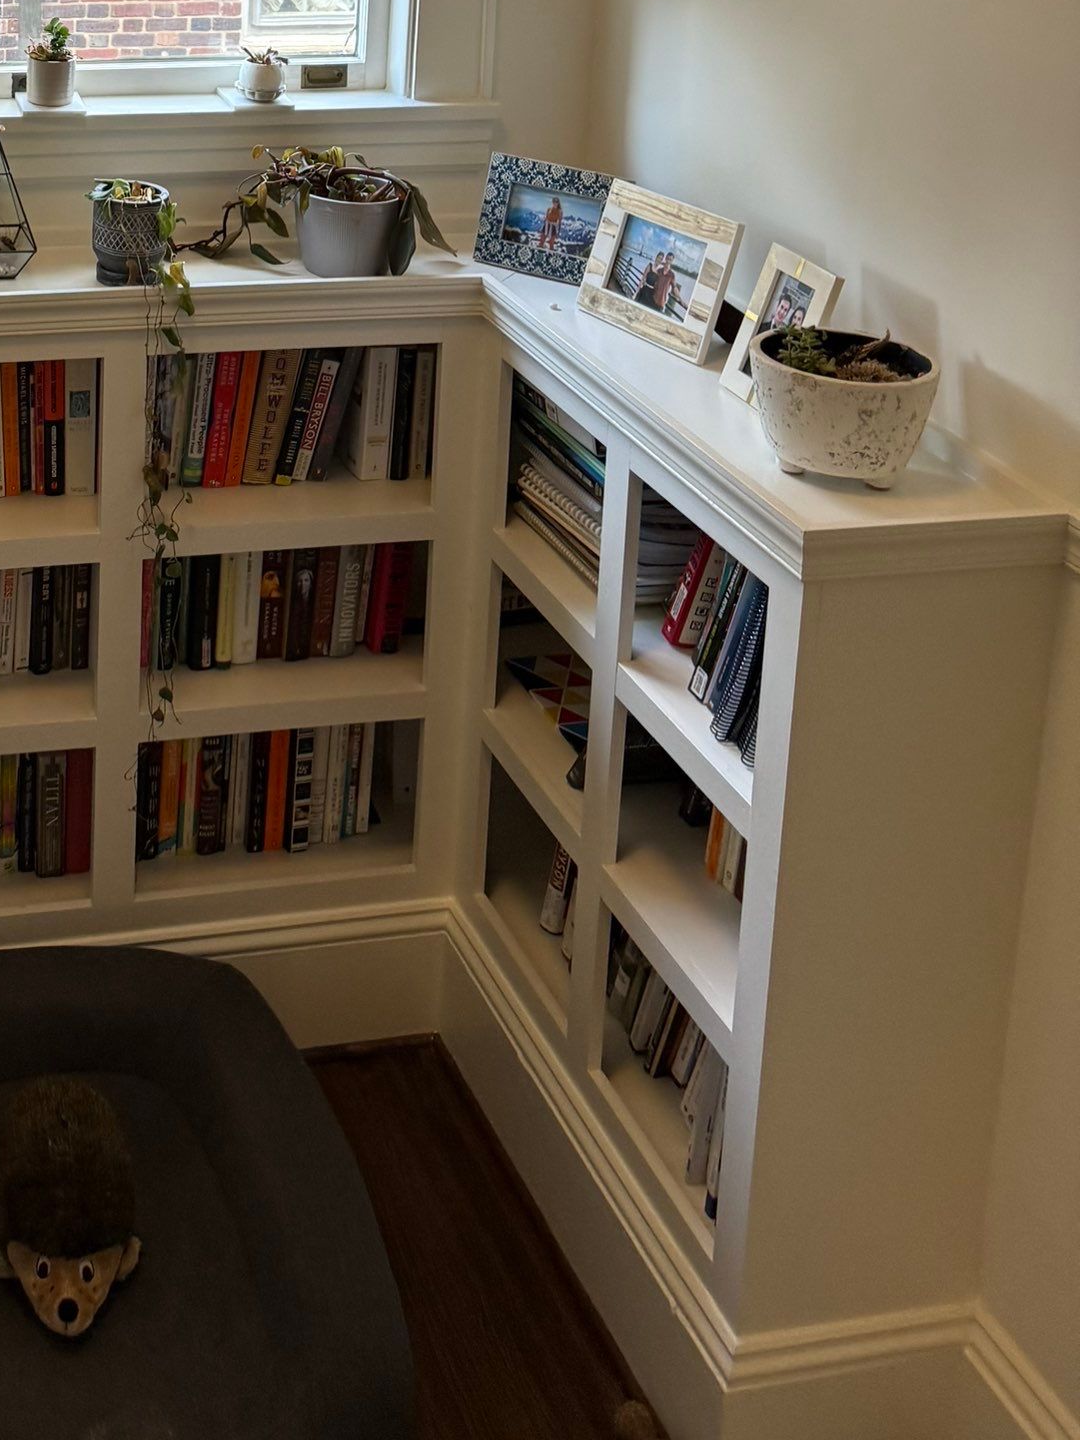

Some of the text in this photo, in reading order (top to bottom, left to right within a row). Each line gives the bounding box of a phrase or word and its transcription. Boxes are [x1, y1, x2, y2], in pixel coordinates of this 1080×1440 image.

[302, 375, 333, 450] BILL BRYSON
[339, 562, 360, 642] INNOVATORS
[45, 773, 60, 827] TITAN
[552, 849, 569, 890] RYSON
